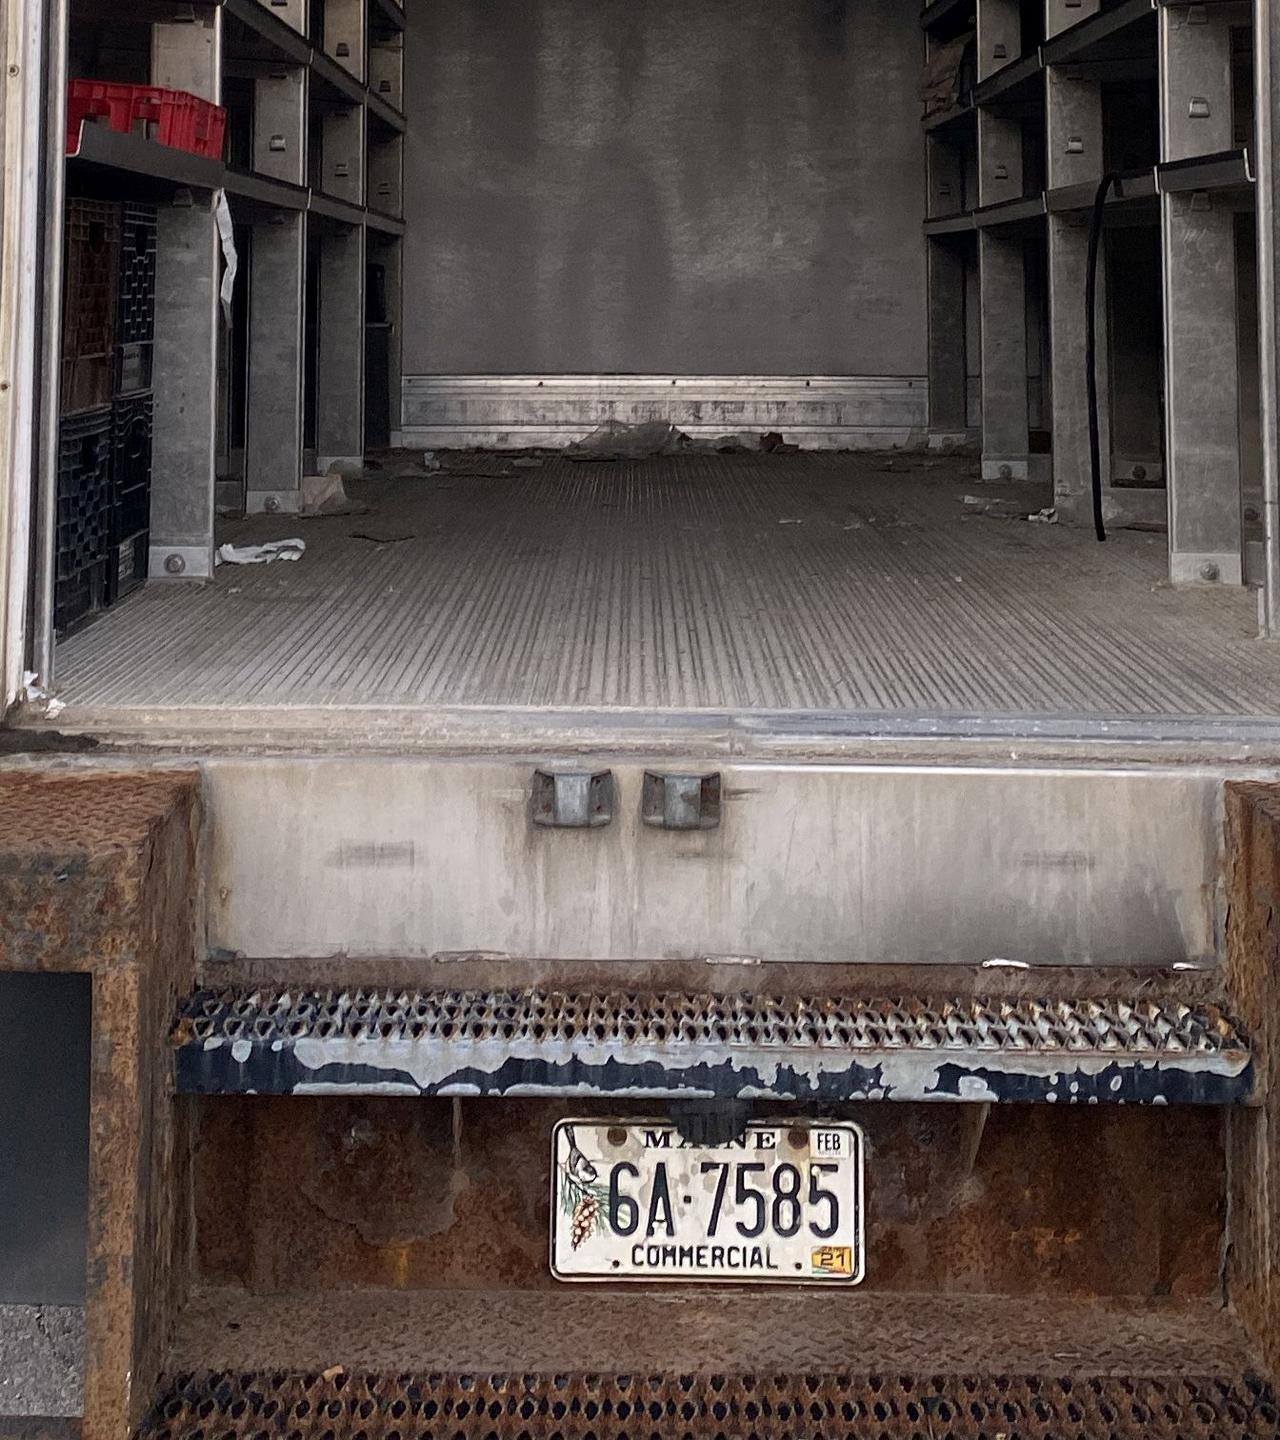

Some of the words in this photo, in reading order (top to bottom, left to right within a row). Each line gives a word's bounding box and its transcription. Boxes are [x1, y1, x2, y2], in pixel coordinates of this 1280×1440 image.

[817, 1132, 841, 1152] FEB
[631, 1244, 779, 1271] COMMERCIAL
[820, 1253, 845, 1266] 21
